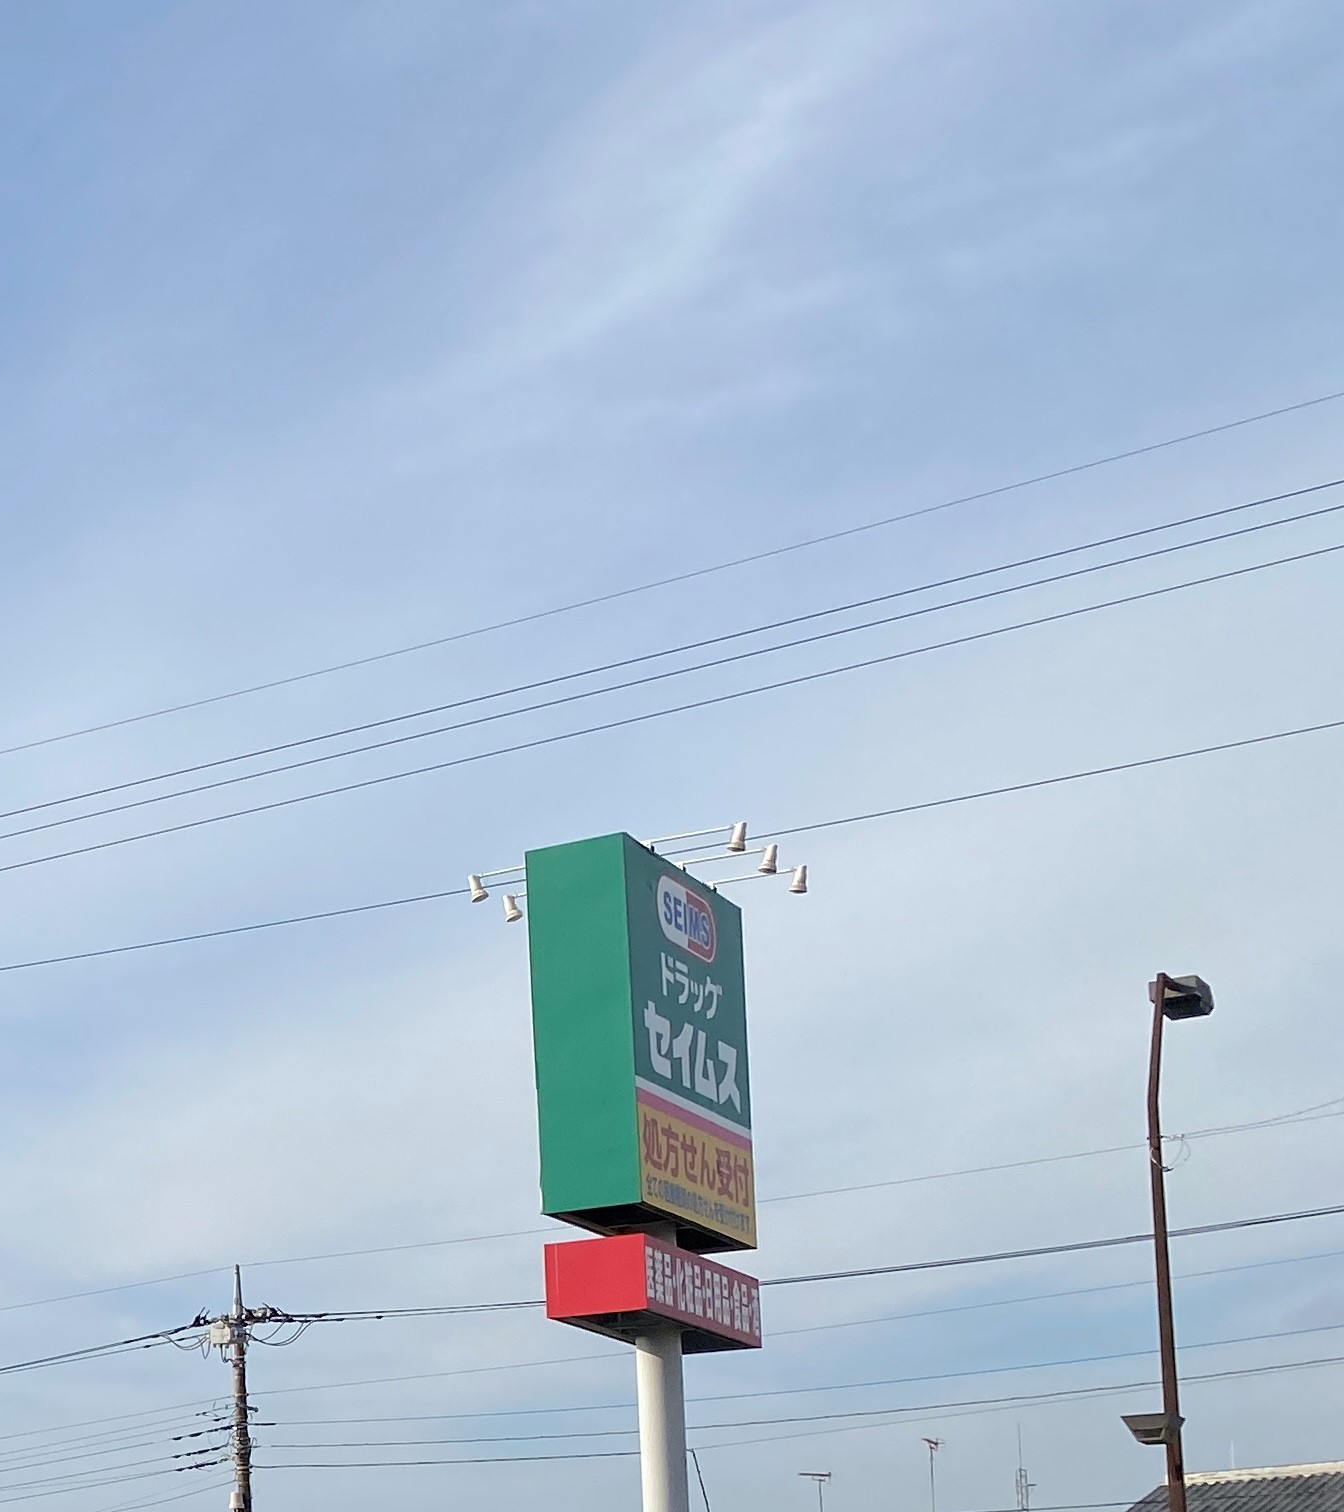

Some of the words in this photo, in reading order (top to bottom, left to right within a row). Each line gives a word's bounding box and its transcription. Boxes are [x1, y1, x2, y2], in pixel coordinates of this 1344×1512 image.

[663, 890, 711, 948] SEIMS
[660, 951, 723, 1020] ドラッグ
[644, 1000, 741, 1115] セイムス
[643, 1112, 749, 1208] 処方せん受付
